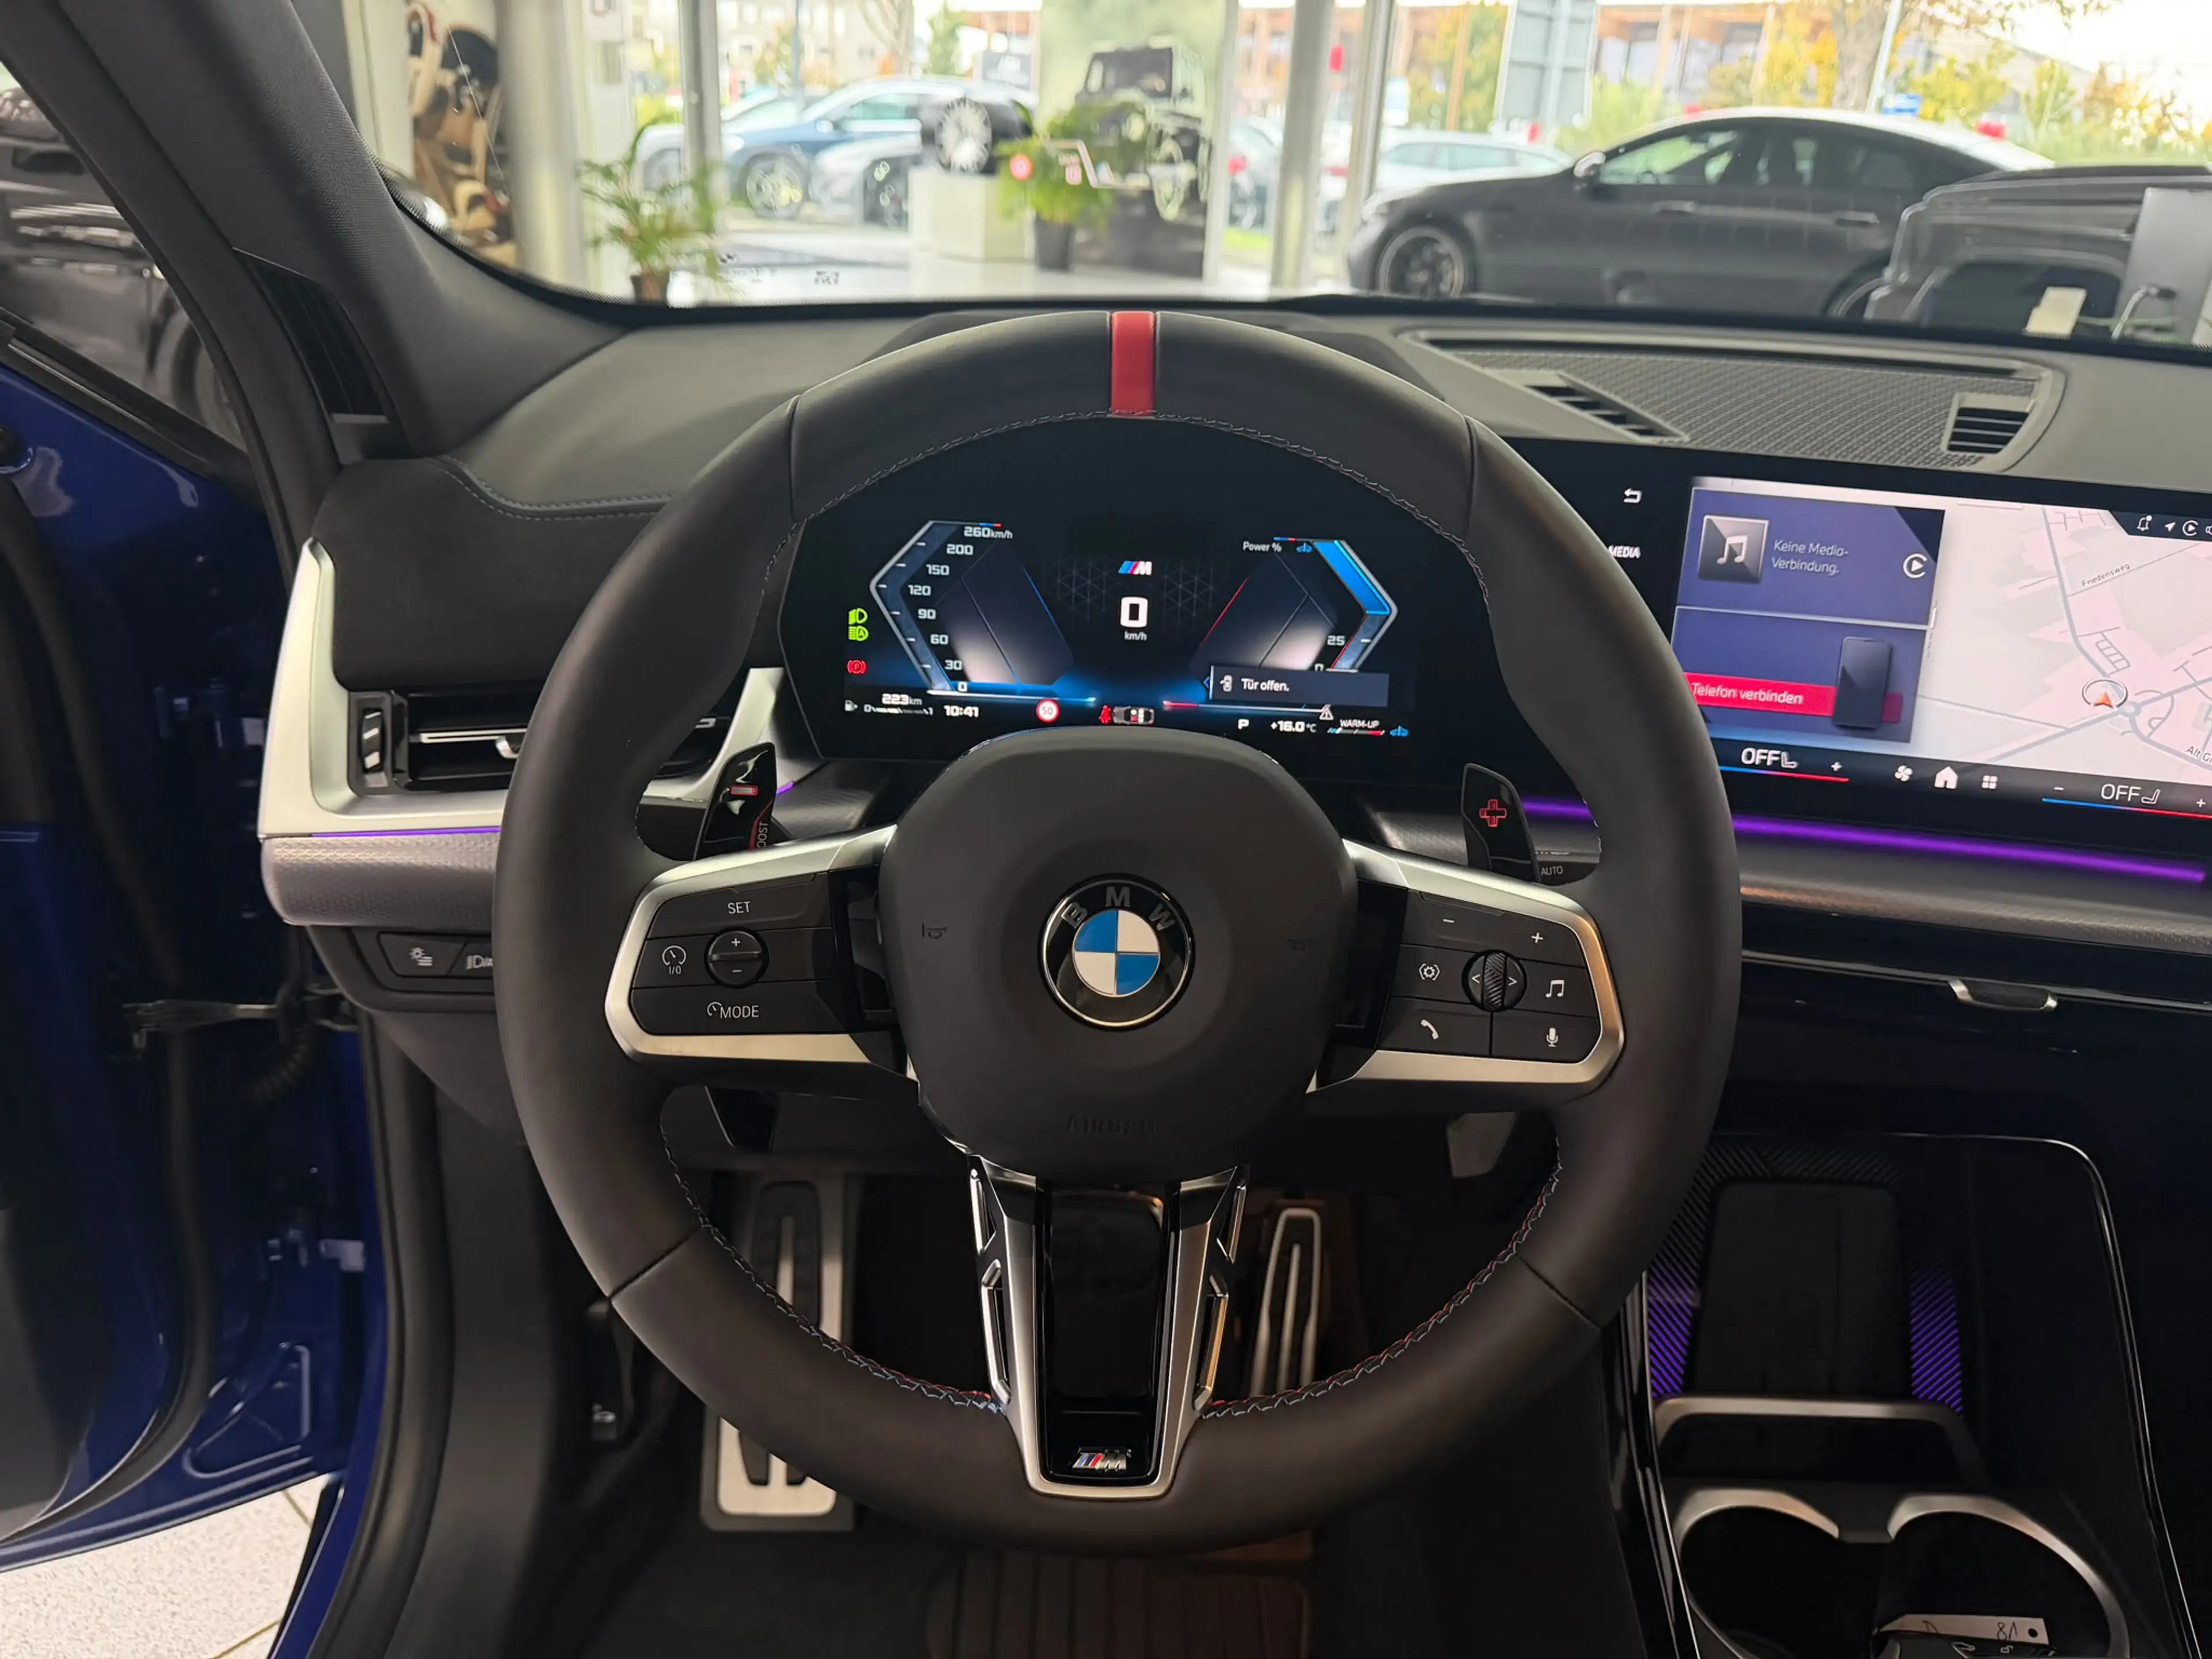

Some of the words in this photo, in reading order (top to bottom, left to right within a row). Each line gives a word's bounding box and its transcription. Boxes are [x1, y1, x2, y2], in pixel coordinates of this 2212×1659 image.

[946, 544, 974, 555] 200
[1243, 541, 1269, 552] Power
[1272, 543, 1282, 552] %
[1608, 545, 1642, 558] MEDIA
[1773, 540, 1806, 554] Keine
[1808, 543, 1849, 557] Media-
[926, 564, 950, 575] 150
[1771, 557, 1839, 576] Verbindung.
[2081, 563, 2131, 586] Friedensweg
[908, 585, 931, 596] 120
[918, 609, 937, 620] 90
[1120, 596, 1149, 627] 0
[930, 634, 949, 645] 60
[1124, 631, 1147, 642] km/h
[1327, 635, 1345, 646] 25
[945, 660, 963, 671] 30
[957, 681, 968, 692] 0
[1241, 678, 1260, 691] Tür
[1263, 681, 1290, 692] offen.
[1691, 683, 1736, 699] Telefon
[1739, 689, 1803, 704] verbinden
[944, 704, 979, 718] 10:41
[1042, 706, 1054, 716] 50
[1238, 718, 1249, 730] P
[1340, 719, 1380, 728] WARM-UP
[1740, 748, 1781, 767] OFF
[2184, 745, 2201, 759] Alt
[2101, 783, 2141, 802] OFF
[756, 821, 769, 848] OOST
[1540, 865, 1564, 876] AUTO
[727, 901, 751, 915] SET
[1060, 885, 1176, 931] BMW
[719, 1005, 760, 1019] MODE
